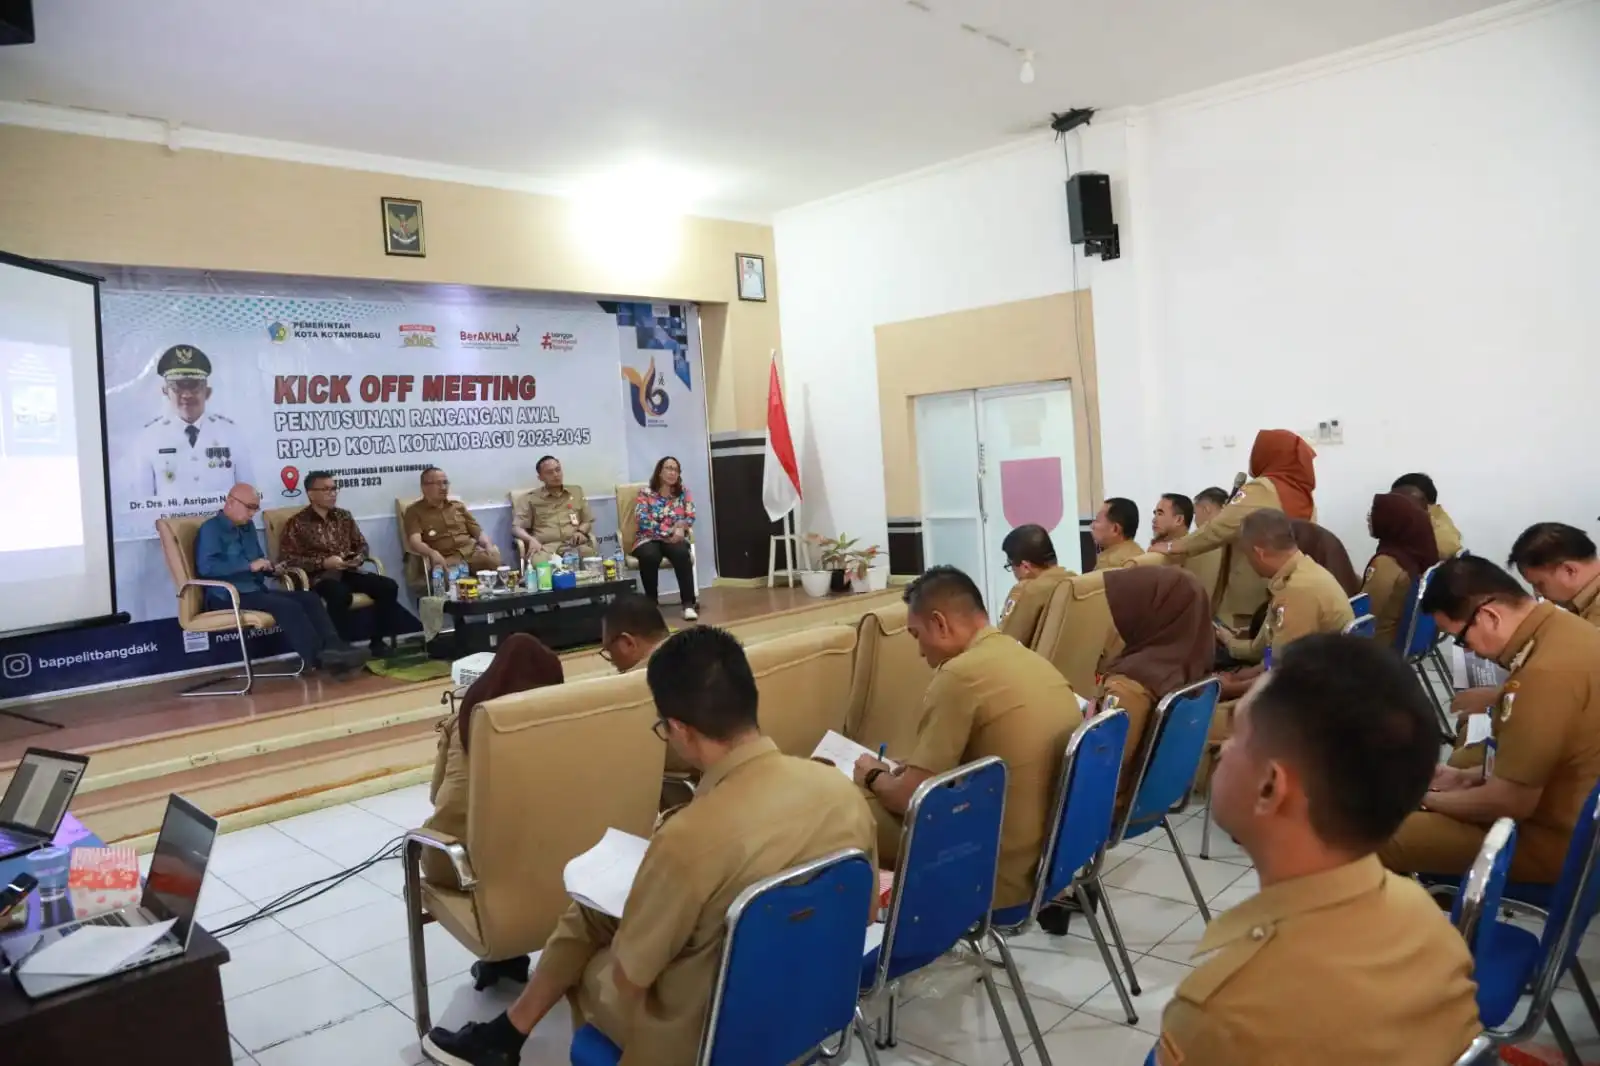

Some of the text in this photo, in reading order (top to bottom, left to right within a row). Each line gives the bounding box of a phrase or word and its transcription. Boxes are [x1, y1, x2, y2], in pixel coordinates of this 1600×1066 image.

[293, 321, 351, 329] PEMERINTAH
[294, 331, 381, 339] KOTA KOTAMOBAGU
[460, 328, 520, 342] BerAKHLAK
[274, 374, 536, 405] KICK OFF MEETING
[274, 405, 560, 432] PENYUSUNAN RANCANGAN AWAL
[277, 427, 591, 459] RPJPD KOTA KOTAMOBAGU 2025-2045
[361, 476, 383, 487] 2023
[129, 501, 144, 510] Dr.
[146, 500, 165, 509] Drs.
[183, 496, 218, 506] Asripan
[39, 641, 159, 668] bappelitbangdakk
